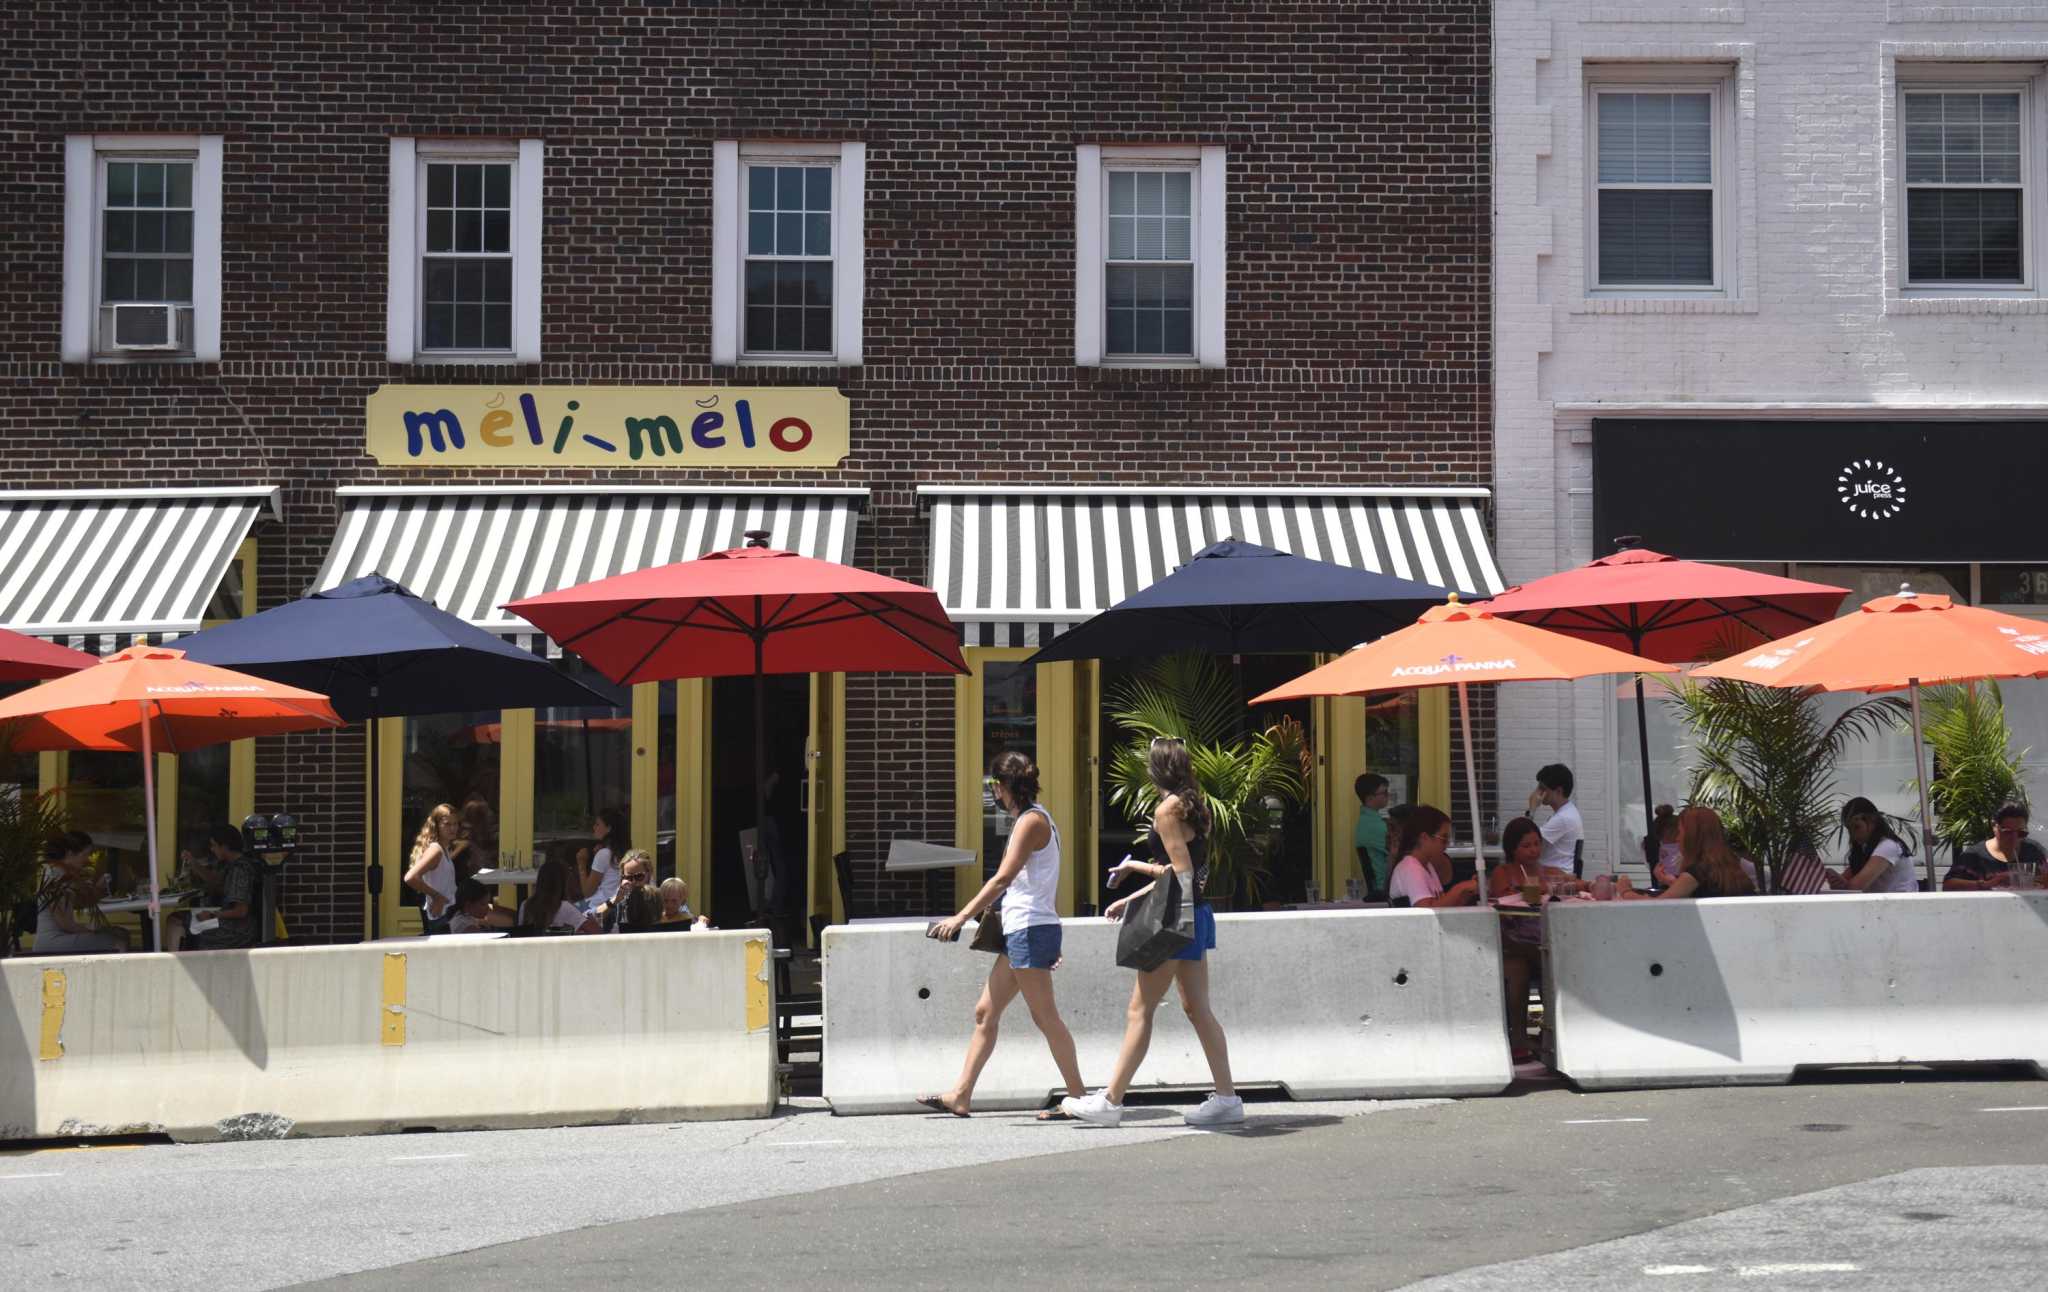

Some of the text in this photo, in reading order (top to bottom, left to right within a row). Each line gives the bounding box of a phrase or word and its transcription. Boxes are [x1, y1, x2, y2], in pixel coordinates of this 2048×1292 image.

[1853, 480, 1892, 497] juice
[1391, 659, 1516, 677] ACQUA PANNA
